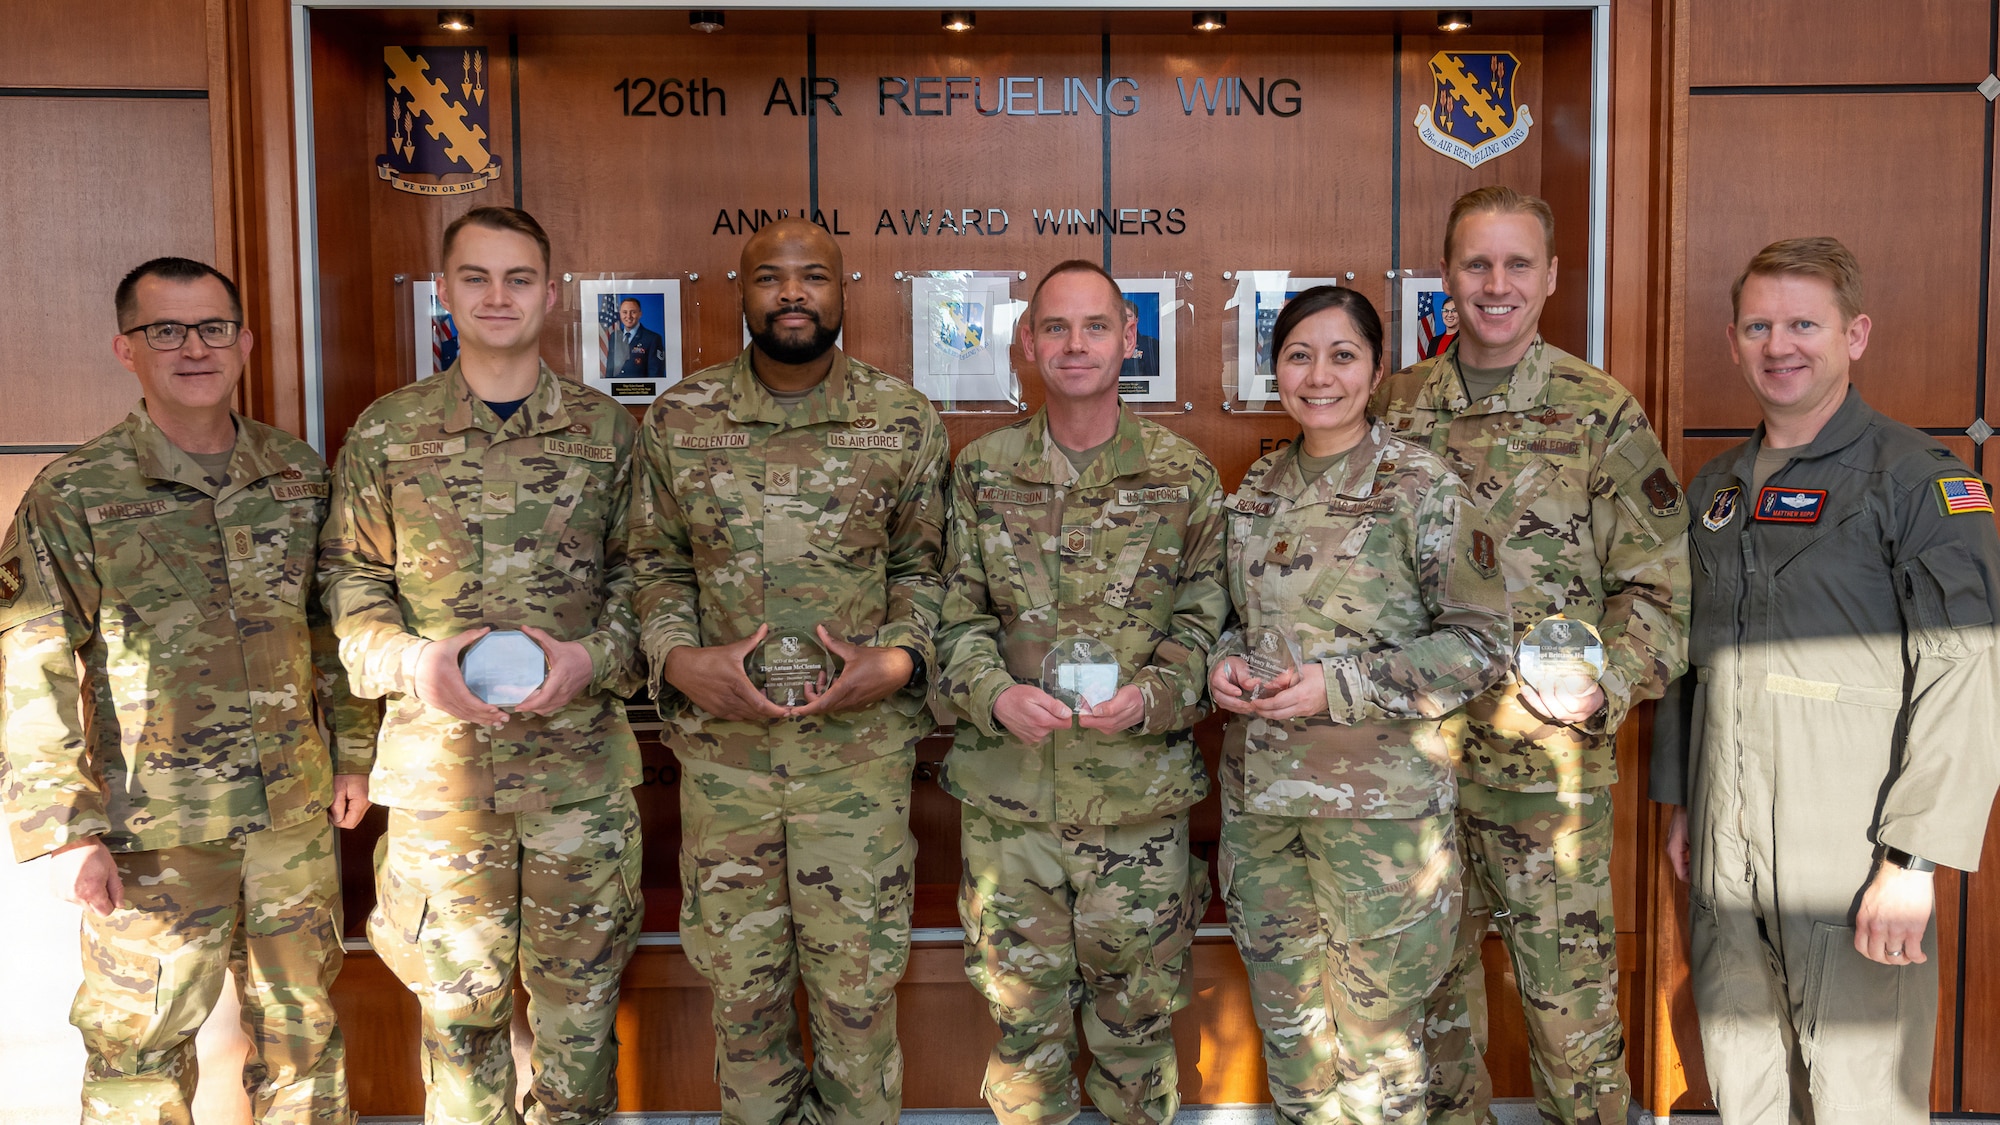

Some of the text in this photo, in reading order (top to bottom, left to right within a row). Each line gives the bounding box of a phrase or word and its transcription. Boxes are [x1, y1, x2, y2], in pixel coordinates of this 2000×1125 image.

[613, 76, 1302, 118] 126th AIR REFUELING WING
[1437, 139, 1454, 154] AIR
[1453, 142, 1501, 164] REFUELING
[1500, 128, 1526, 149] WING
[402, 181, 477, 193] WE WIN OR DIE
[712, 208, 1187, 235] ANNAL AWARD WINNERS
[410, 441, 444, 457] OLSON
[680, 434, 745, 449] MCCLENTON
[849, 436, 865, 447] AIR
[867, 435, 898, 448] FORCE
[1531, 439, 1547, 451] AIR
[1550, 440, 1580, 455] FORCE
[567, 442, 583, 456] AIR
[583, 445, 613, 460] FORCE
[286, 485, 303, 498] AIR
[982, 487, 1043, 504] MCPHERSON
[1142, 490, 1156, 501] AIR
[1156, 488, 1181, 501] FORCE
[97, 499, 168, 521] HARPSTER
